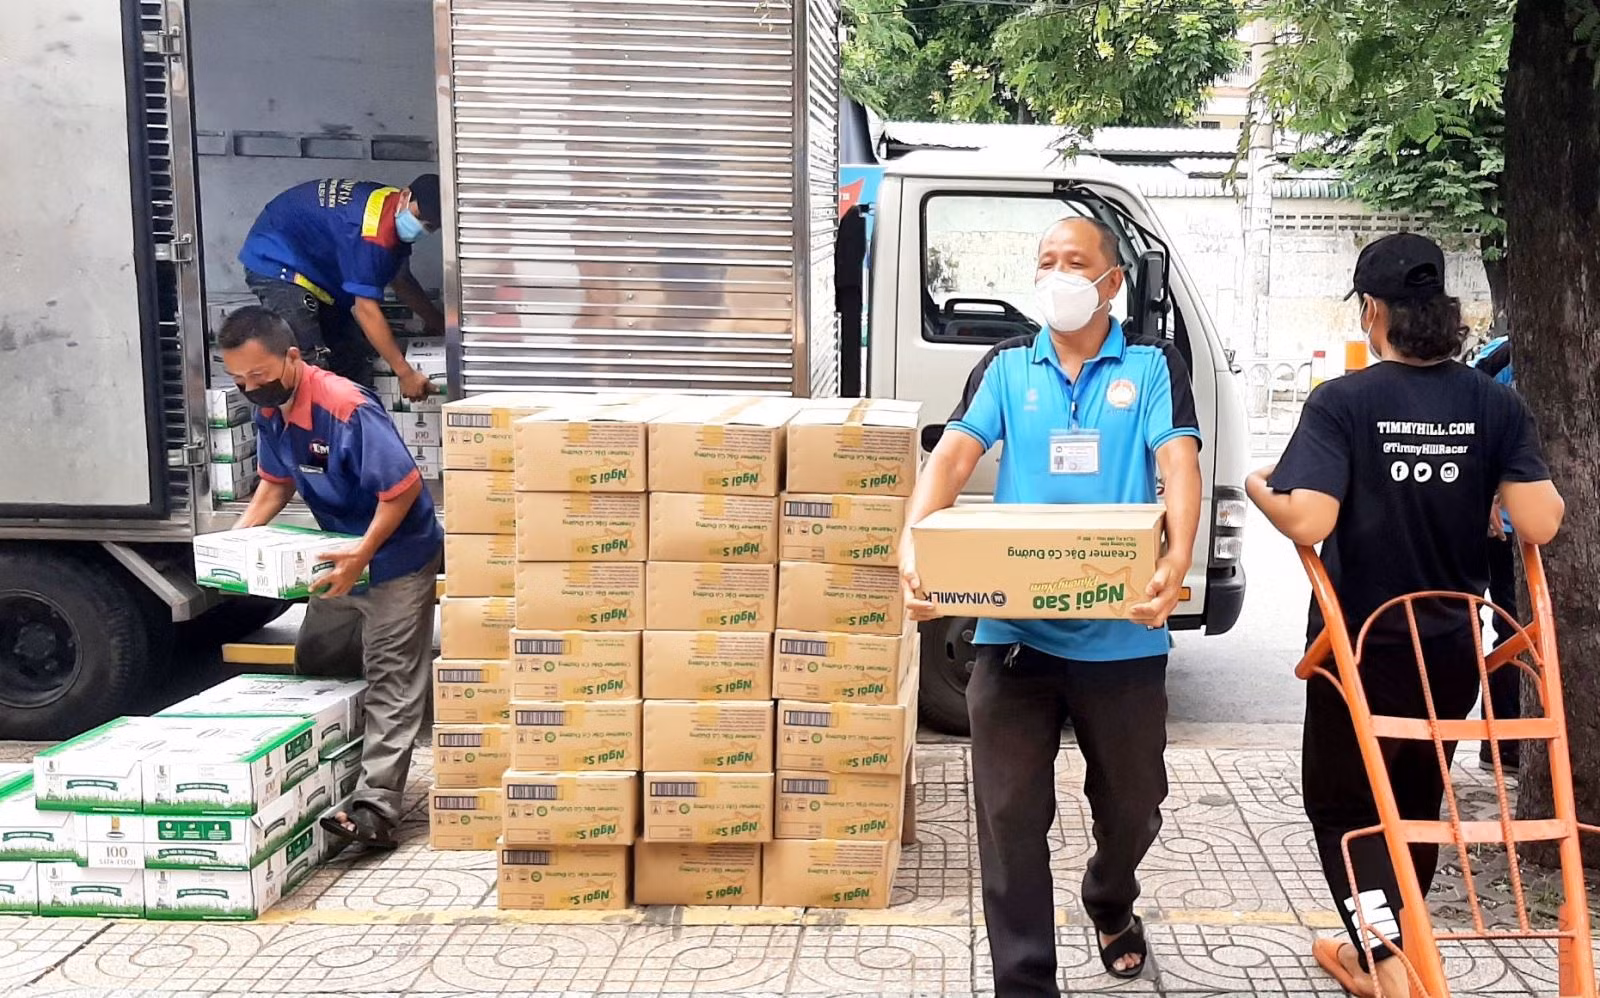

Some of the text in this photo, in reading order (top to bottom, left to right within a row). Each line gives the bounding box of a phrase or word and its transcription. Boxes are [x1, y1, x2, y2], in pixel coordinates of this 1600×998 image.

[1377, 422, 1475, 436] TIMMYHILL.COM
[1008, 546, 1136, 560] Creamer Đặc Có Đường
[1029, 576, 1098, 594] Phương Nam
[1033, 583, 1124, 612] Ngôi Sao
[106, 846, 128, 858] 100
